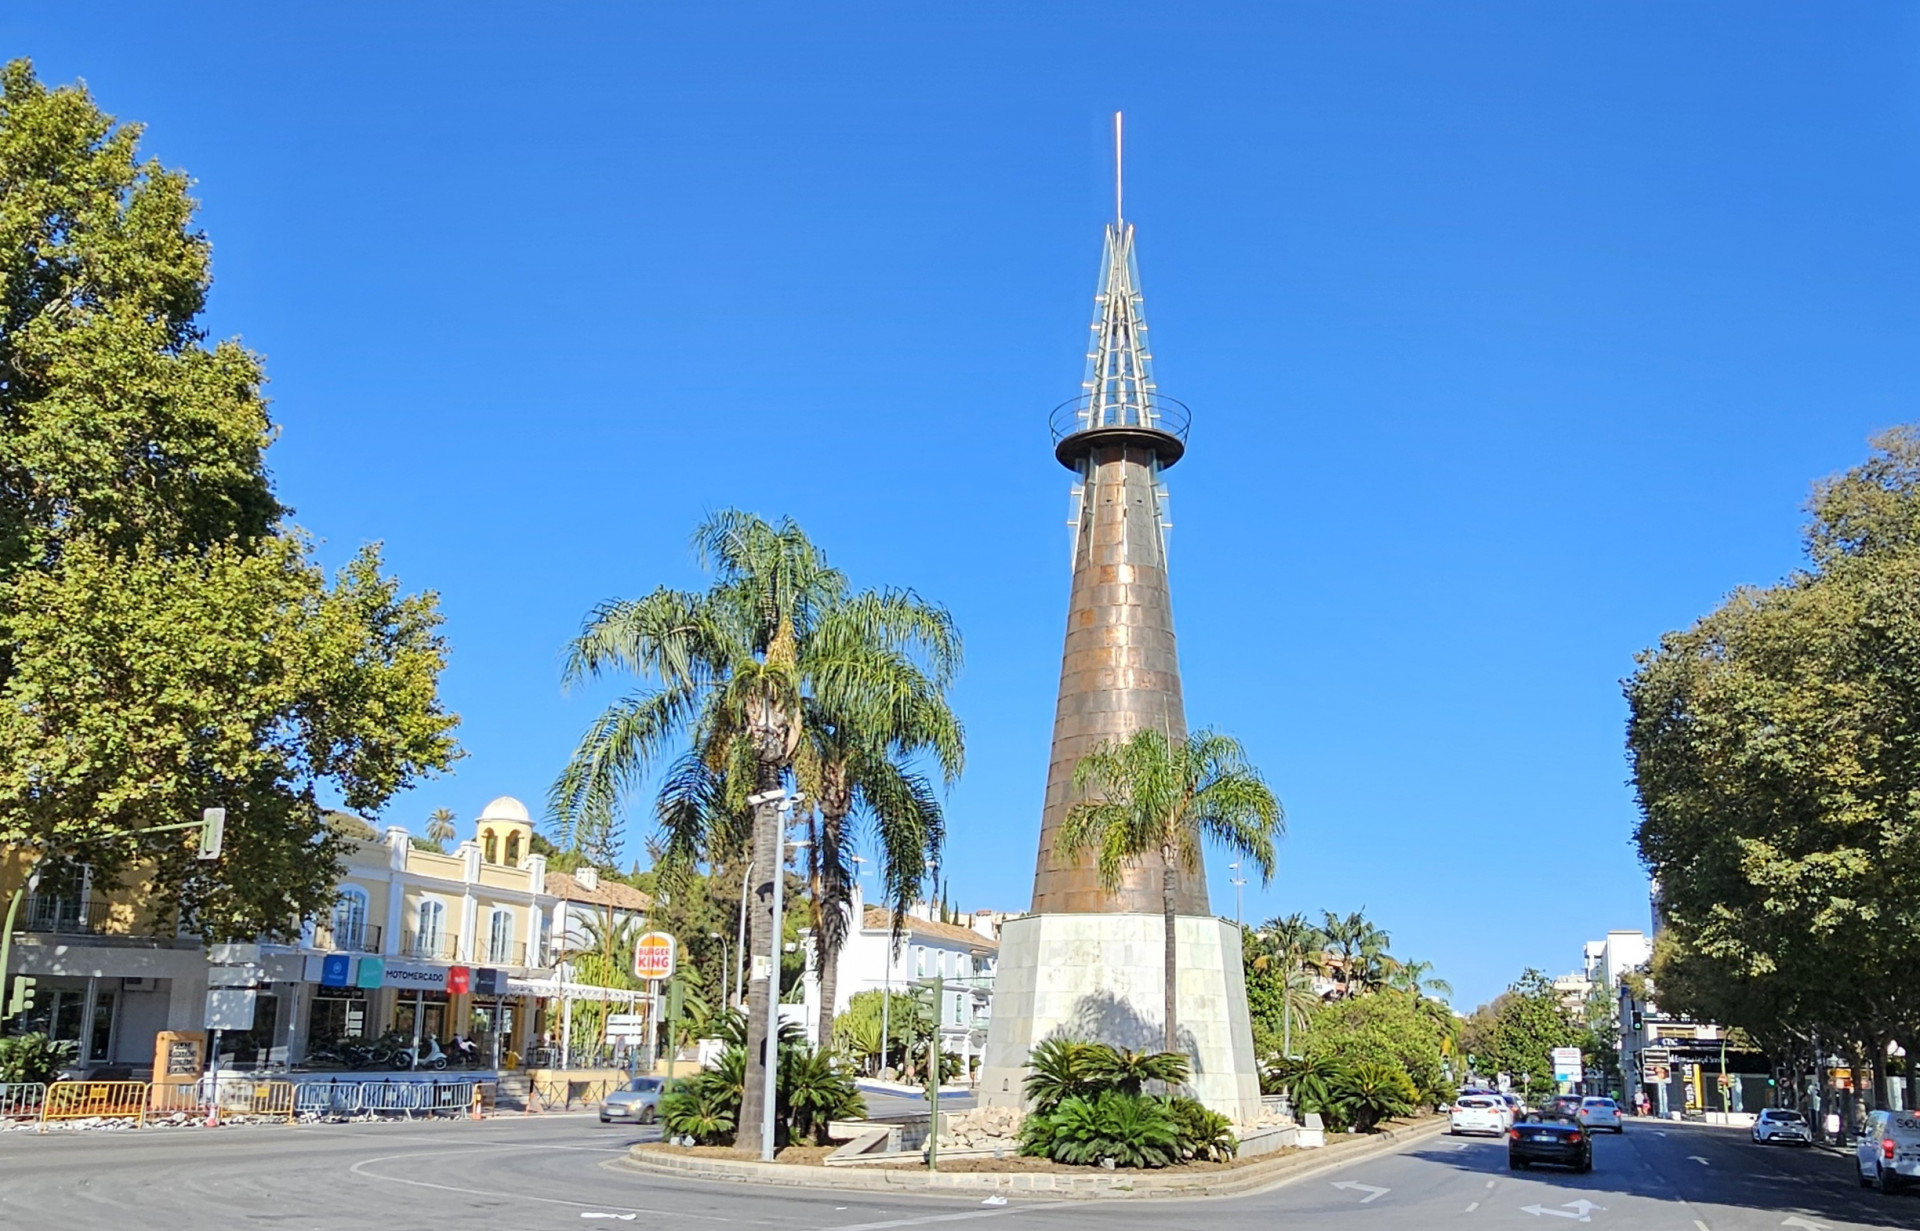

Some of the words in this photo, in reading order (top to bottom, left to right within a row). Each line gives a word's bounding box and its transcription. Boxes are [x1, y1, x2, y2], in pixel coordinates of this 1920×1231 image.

[638, 947, 670, 956] BURGER
[638, 956, 669, 968] KING
[386, 969, 444, 983] MOTOMERCADO
